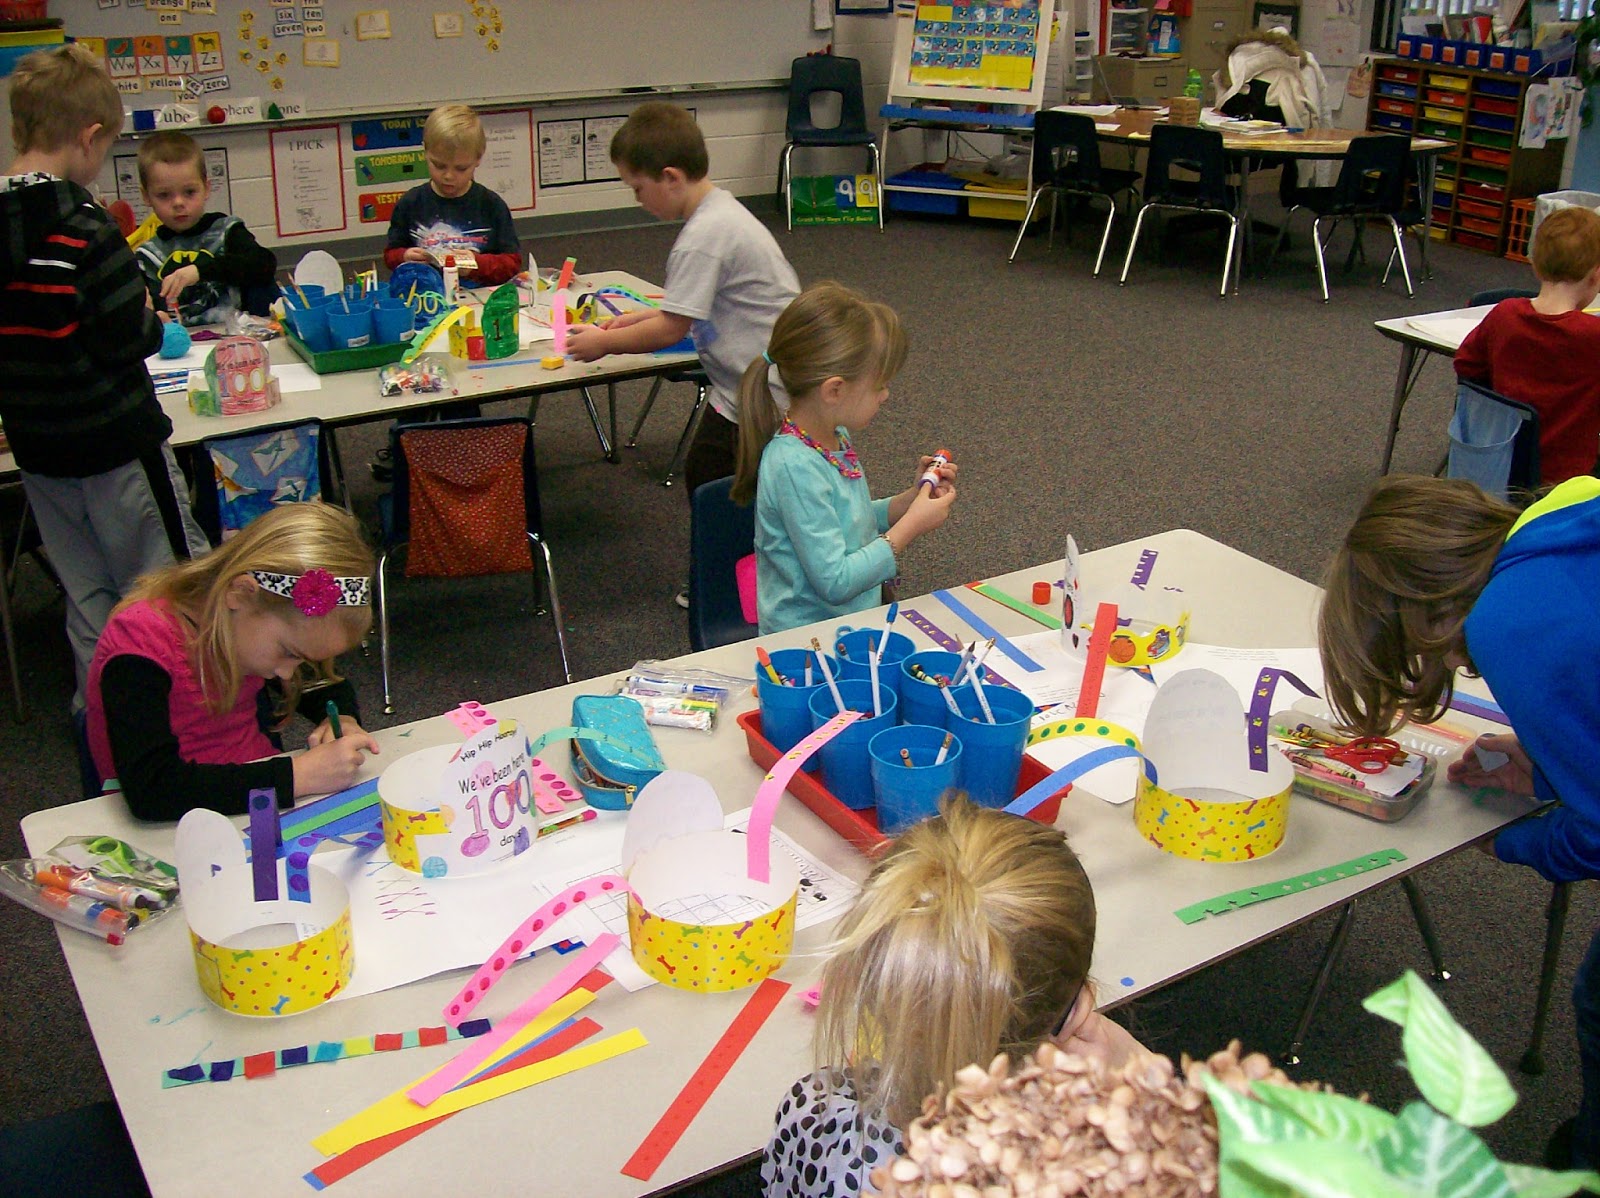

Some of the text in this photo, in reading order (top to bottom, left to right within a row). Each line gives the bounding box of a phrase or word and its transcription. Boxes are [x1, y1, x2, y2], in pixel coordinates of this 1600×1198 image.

[191, 0, 212, 9] pink
[160, 14, 177, 22] one
[279, 10, 293, 19] six
[306, 9, 321, 17] ten
[276, 25, 302, 34] seven
[306, 25, 323, 33] two
[118, 80, 139, 91] hite
[149, 78, 181, 88] yellow
[206, 80, 228, 90] zero
[177, 92, 195, 102] you
[280, 104, 301, 114] one
[382, 119, 411, 130] TODAY
[297, 139, 325, 151] PICK
[369, 154, 415, 167] TOMORROW
[375, 194, 402, 205] YESTE
[460, 750, 476, 762] Hip
[478, 739, 492, 751] Hip
[458, 752, 526, 794] We've been here
[465, 769, 531, 839] 100
[500, 828, 523, 847] days
